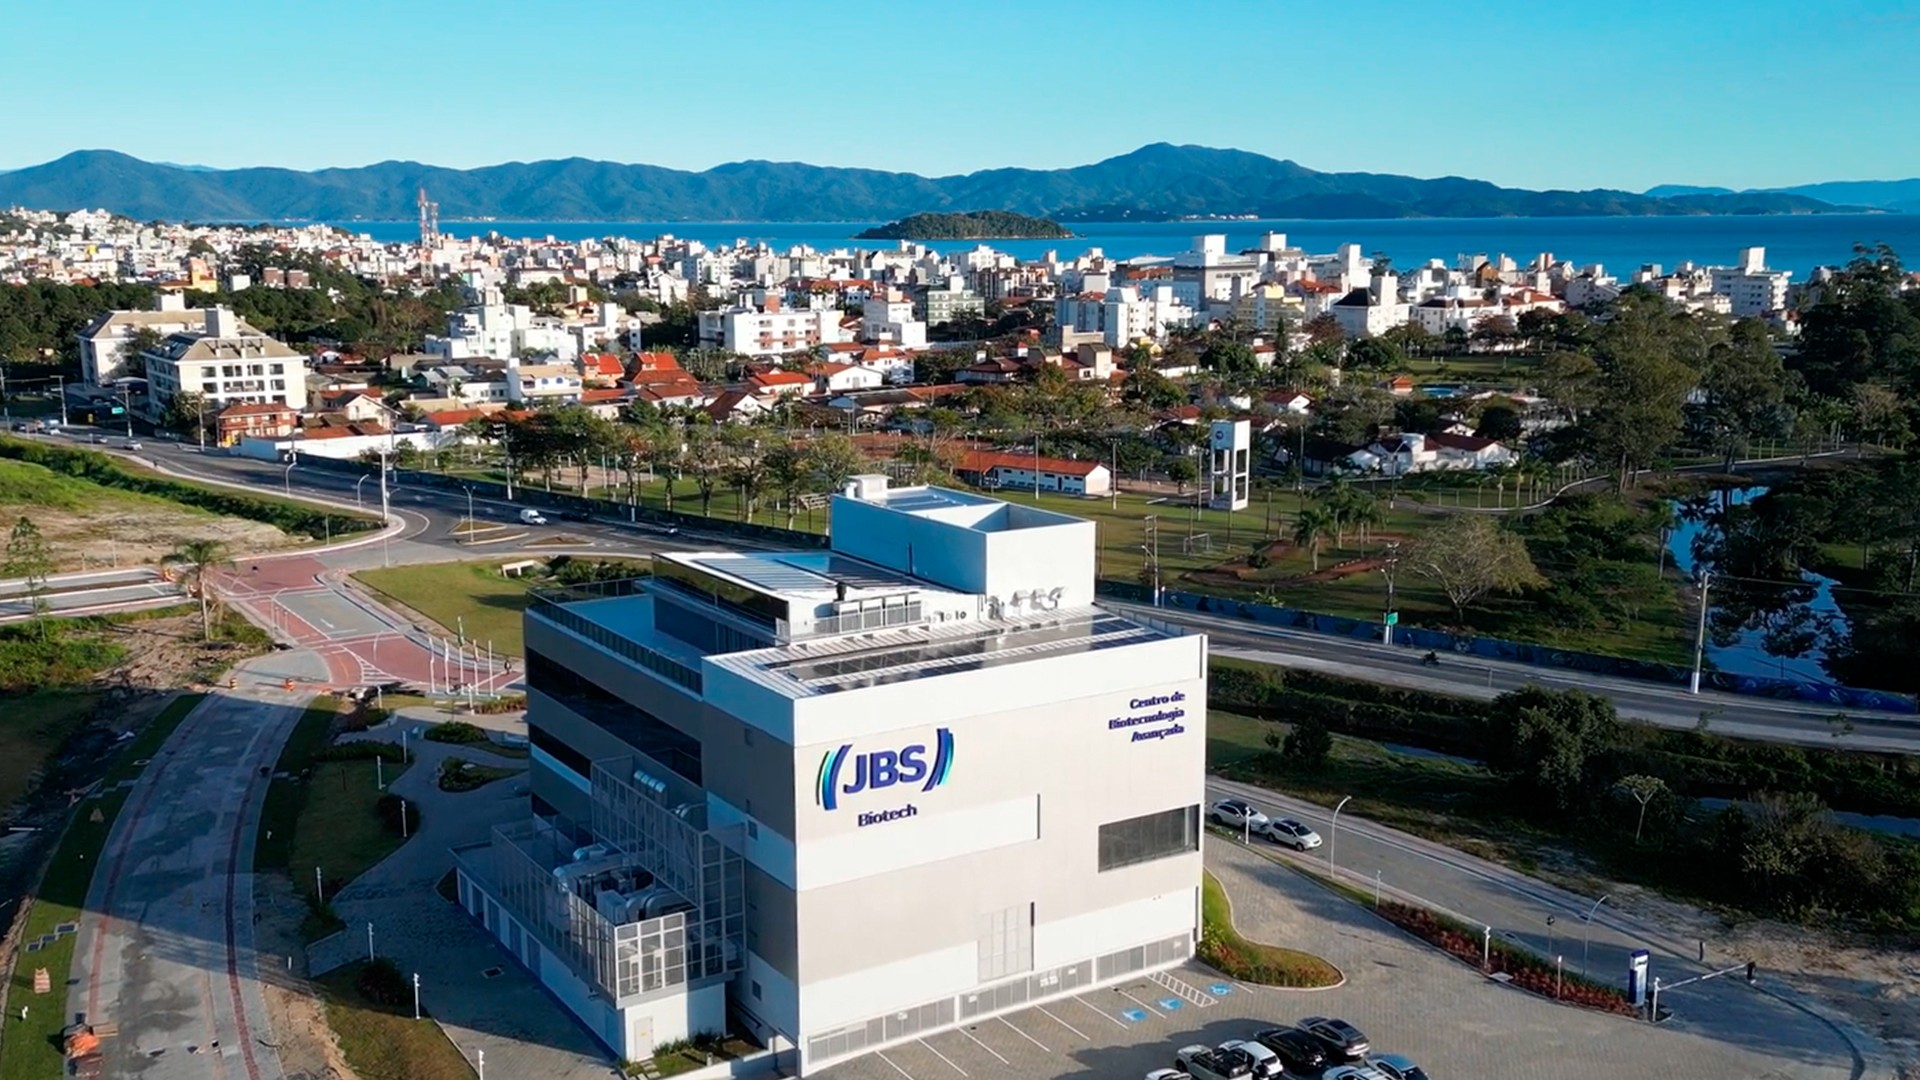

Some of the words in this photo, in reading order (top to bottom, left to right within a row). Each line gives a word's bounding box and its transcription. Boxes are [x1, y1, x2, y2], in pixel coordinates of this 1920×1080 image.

[1130, 696, 1170, 710] Centro
[1170, 691, 1186, 702] de
[1108, 707, 1185, 730] Biotecnologia
[1131, 723, 1185, 742] Avançada
[842, 744, 928, 795] JBS
[857, 803, 918, 828] Biotech
